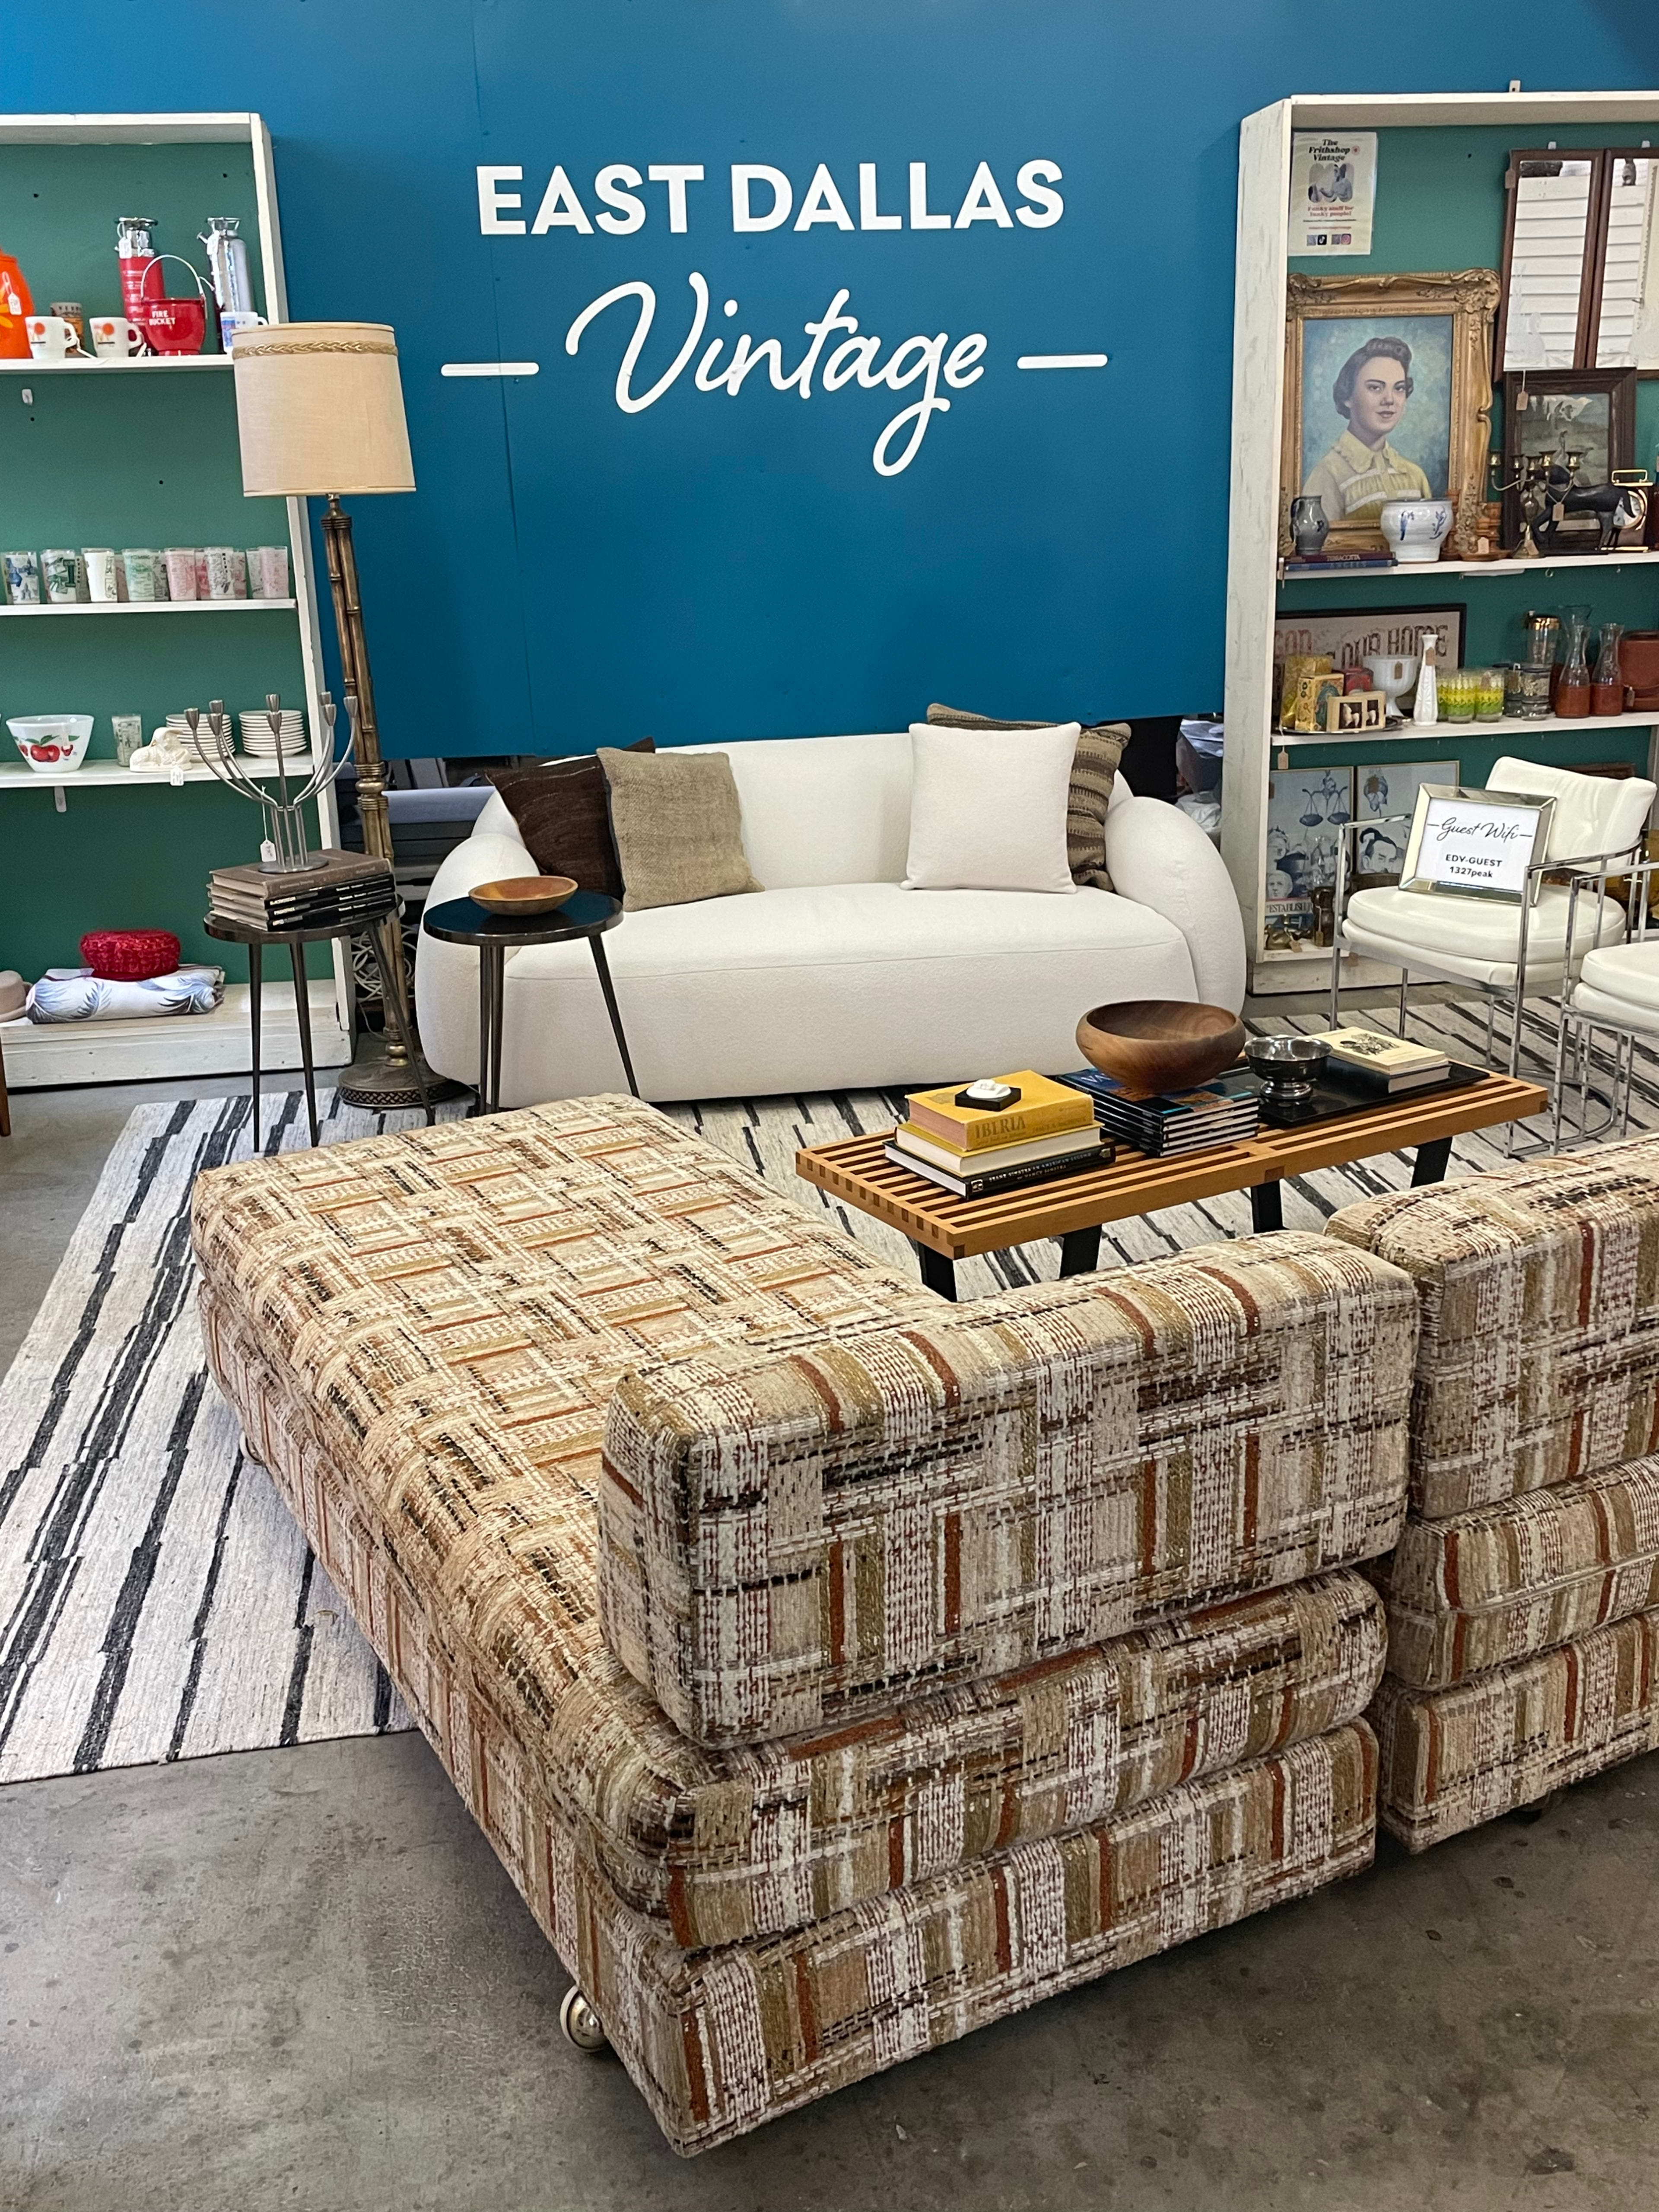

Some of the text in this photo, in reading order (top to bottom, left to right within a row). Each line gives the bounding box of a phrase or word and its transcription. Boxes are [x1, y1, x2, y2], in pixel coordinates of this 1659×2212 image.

[477, 159, 1065, 235] EAST DALLAS
[149, 317, 176, 325] BUCKET
[565, 272, 987, 477] Vintage
[1437, 817, 1519, 843] Guest Wifi
[1449, 866, 1493, 877] 1327peak
